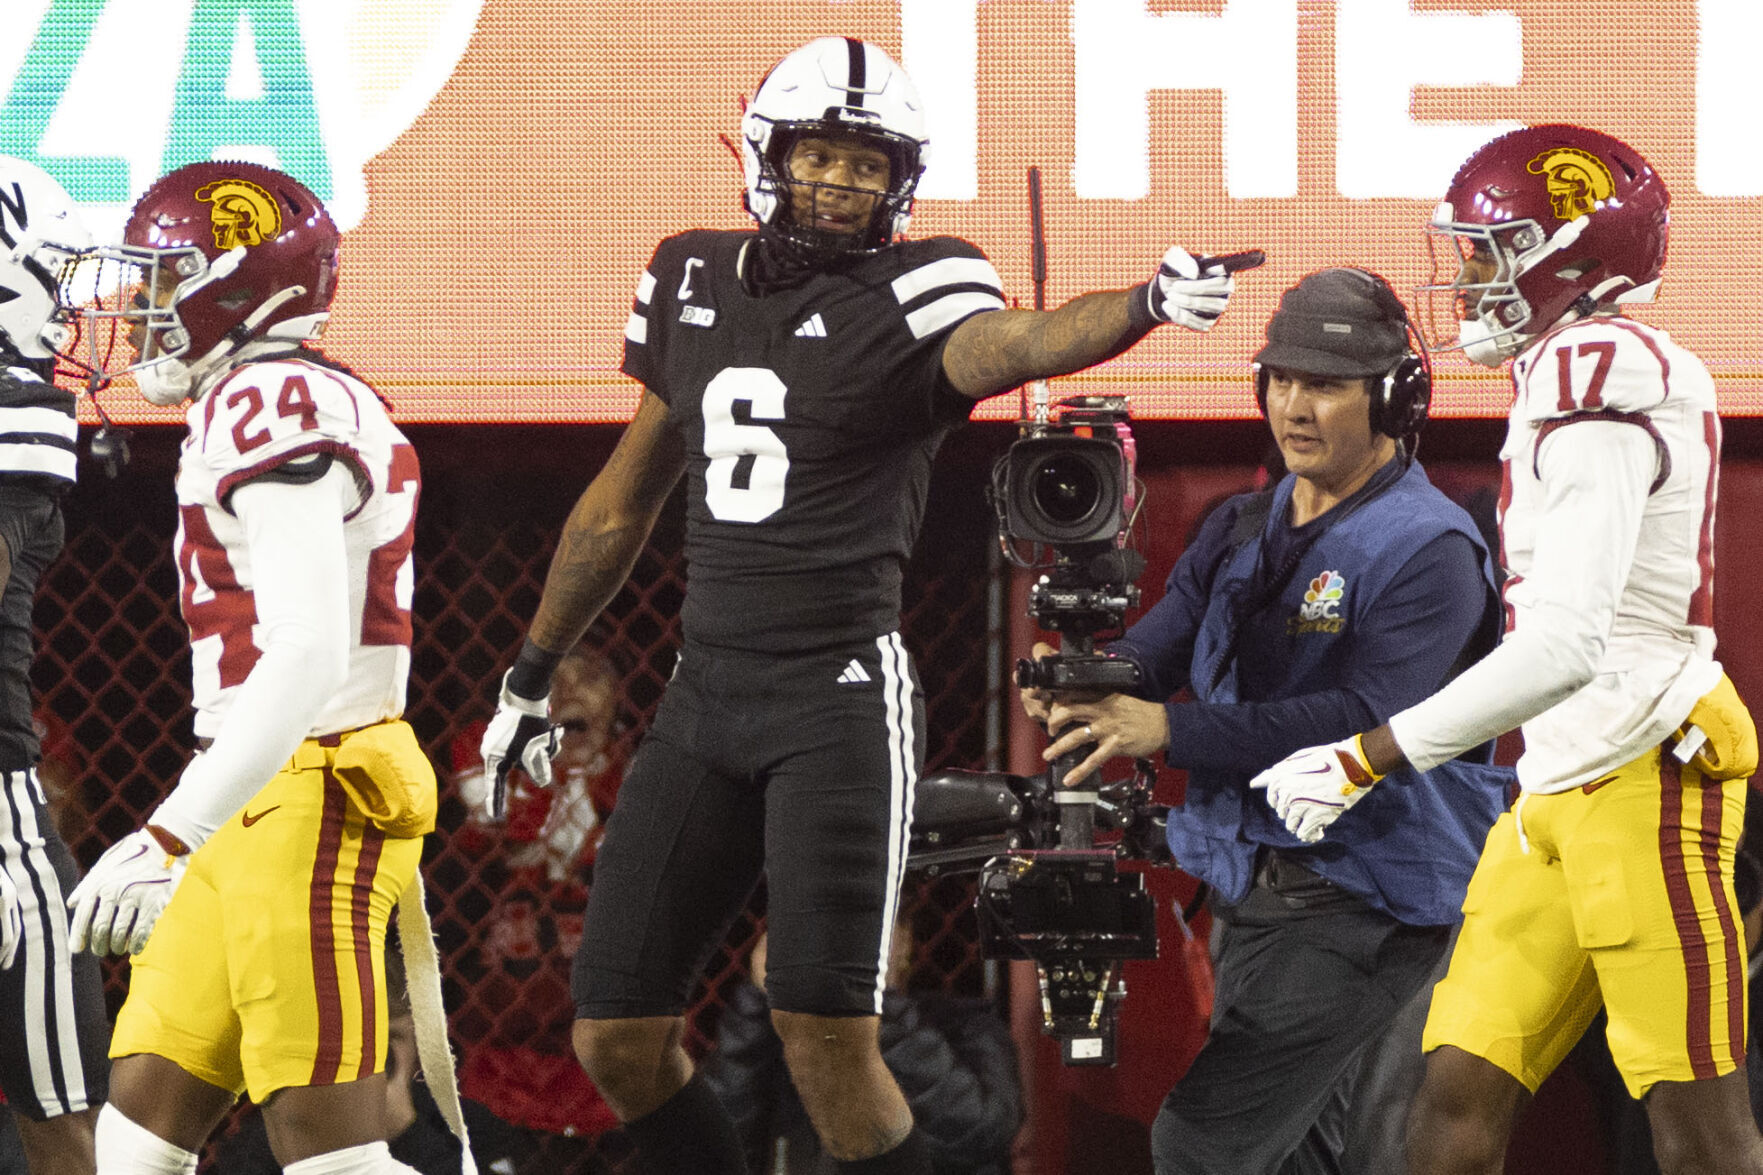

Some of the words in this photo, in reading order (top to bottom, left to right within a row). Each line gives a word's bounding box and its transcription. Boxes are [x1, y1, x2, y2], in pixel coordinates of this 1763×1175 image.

[226, 374, 319, 455] 24
[1556, 341, 1616, 412] 17
[702, 367, 790, 523] 6
[1301, 600, 1340, 620] NBC
